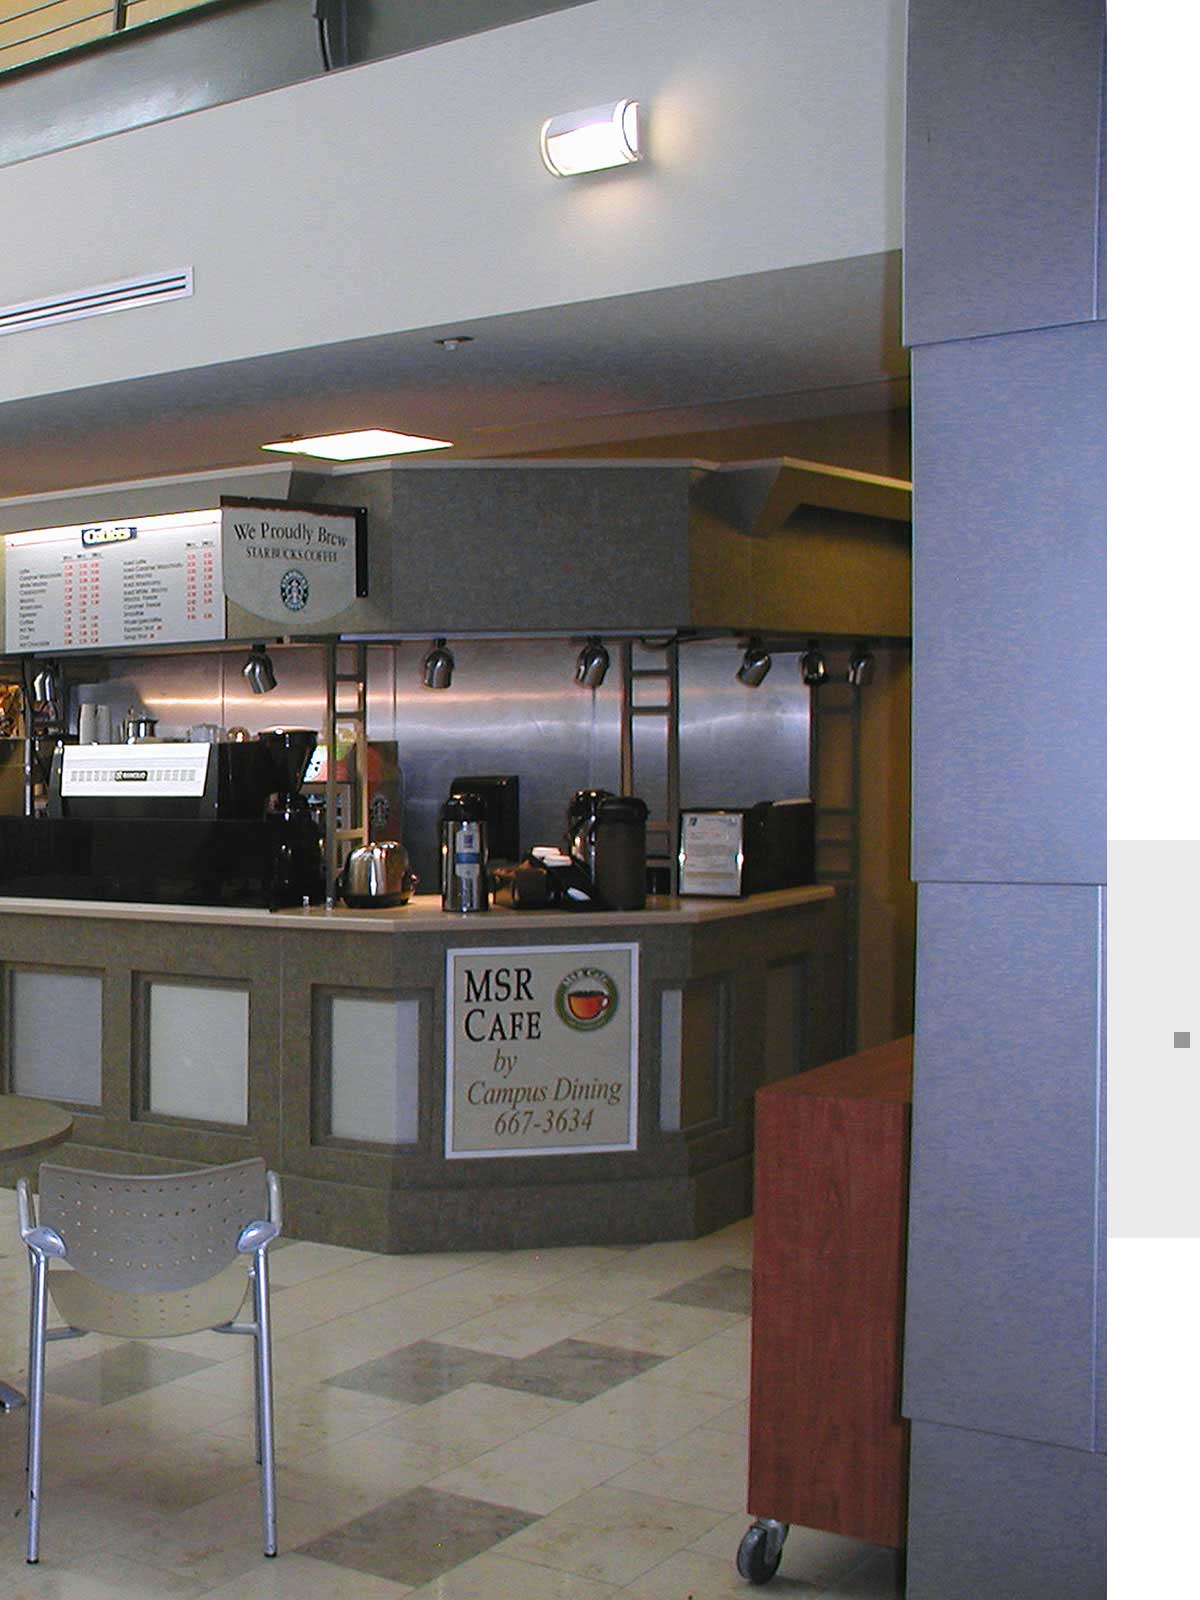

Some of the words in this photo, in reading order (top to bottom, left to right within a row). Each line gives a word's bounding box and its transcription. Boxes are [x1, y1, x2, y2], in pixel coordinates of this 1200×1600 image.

[234, 523, 256, 540] We
[261, 521, 313, 544] Proudly
[318, 527, 348, 547] Brew
[465, 967, 534, 1003] MSR
[465, 1008, 541, 1042] CAFE
[493, 1048, 517, 1078] by
[468, 1080, 548, 1110] Campus
[553, 1077, 622, 1105] Dining
[495, 1108, 593, 1136] 667-3634
